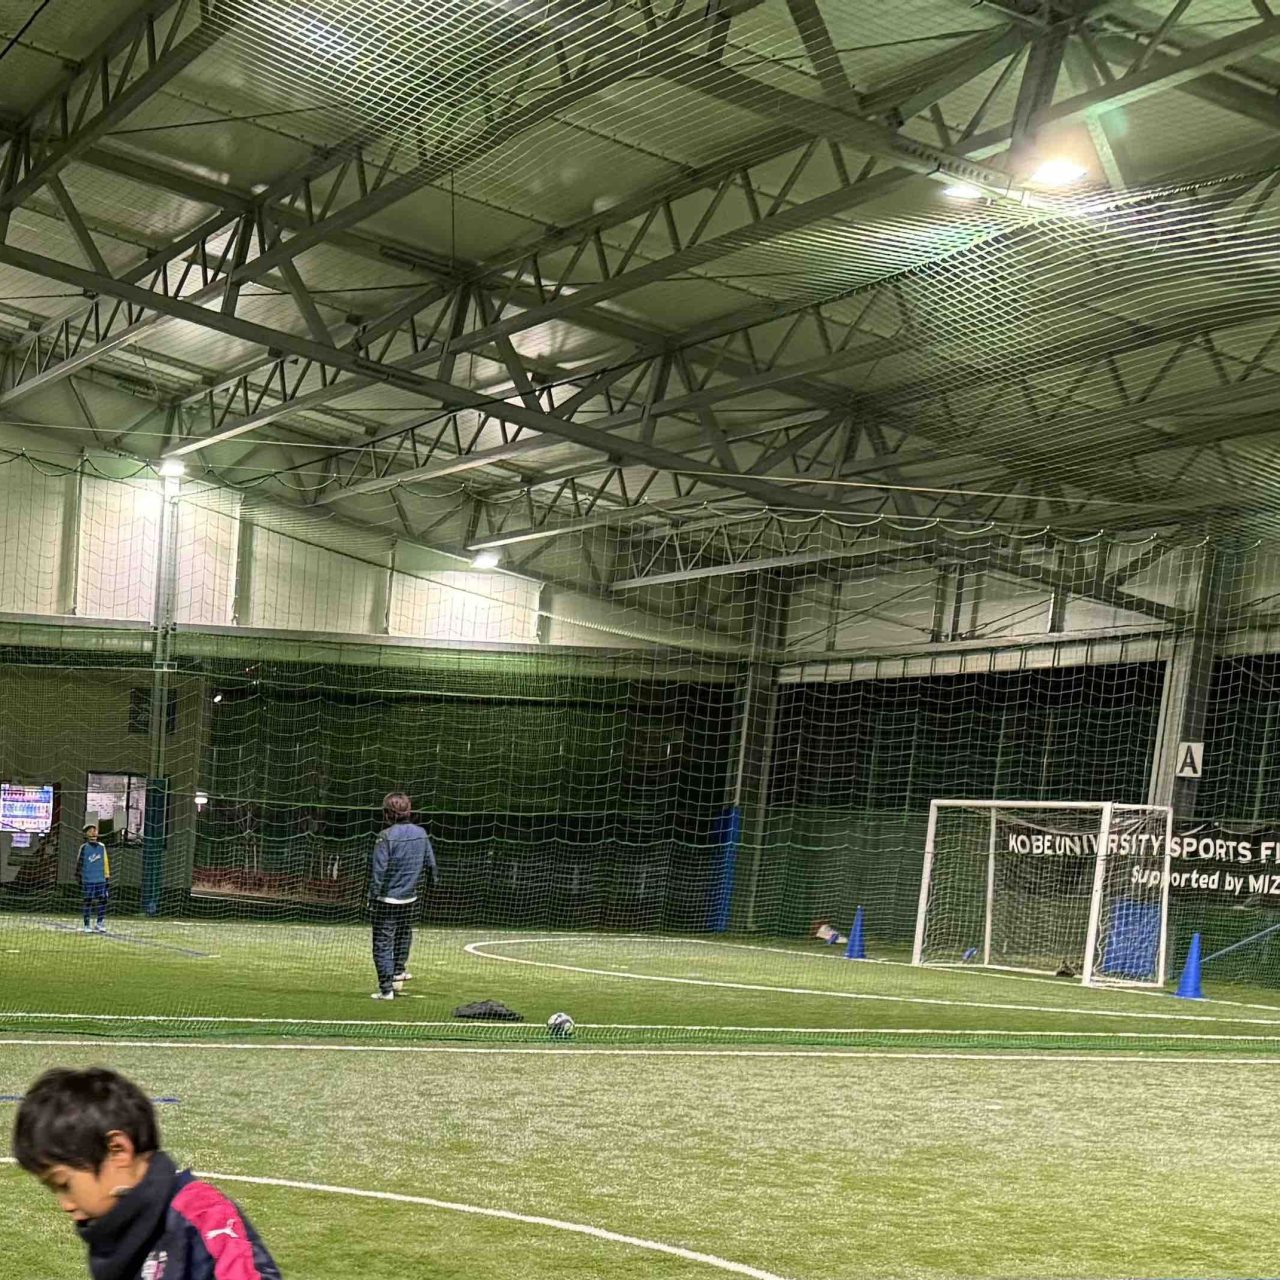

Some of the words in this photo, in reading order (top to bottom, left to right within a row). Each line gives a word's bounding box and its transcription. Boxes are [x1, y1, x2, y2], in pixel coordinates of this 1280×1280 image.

[1179, 745, 1198, 774] A
[1055, 833, 1165, 857] UNIVRSITY
[1170, 837, 1252, 863] SPORTS
[1224, 872, 1244, 895] by
[1248, 874, 1280, 894] MIZ
